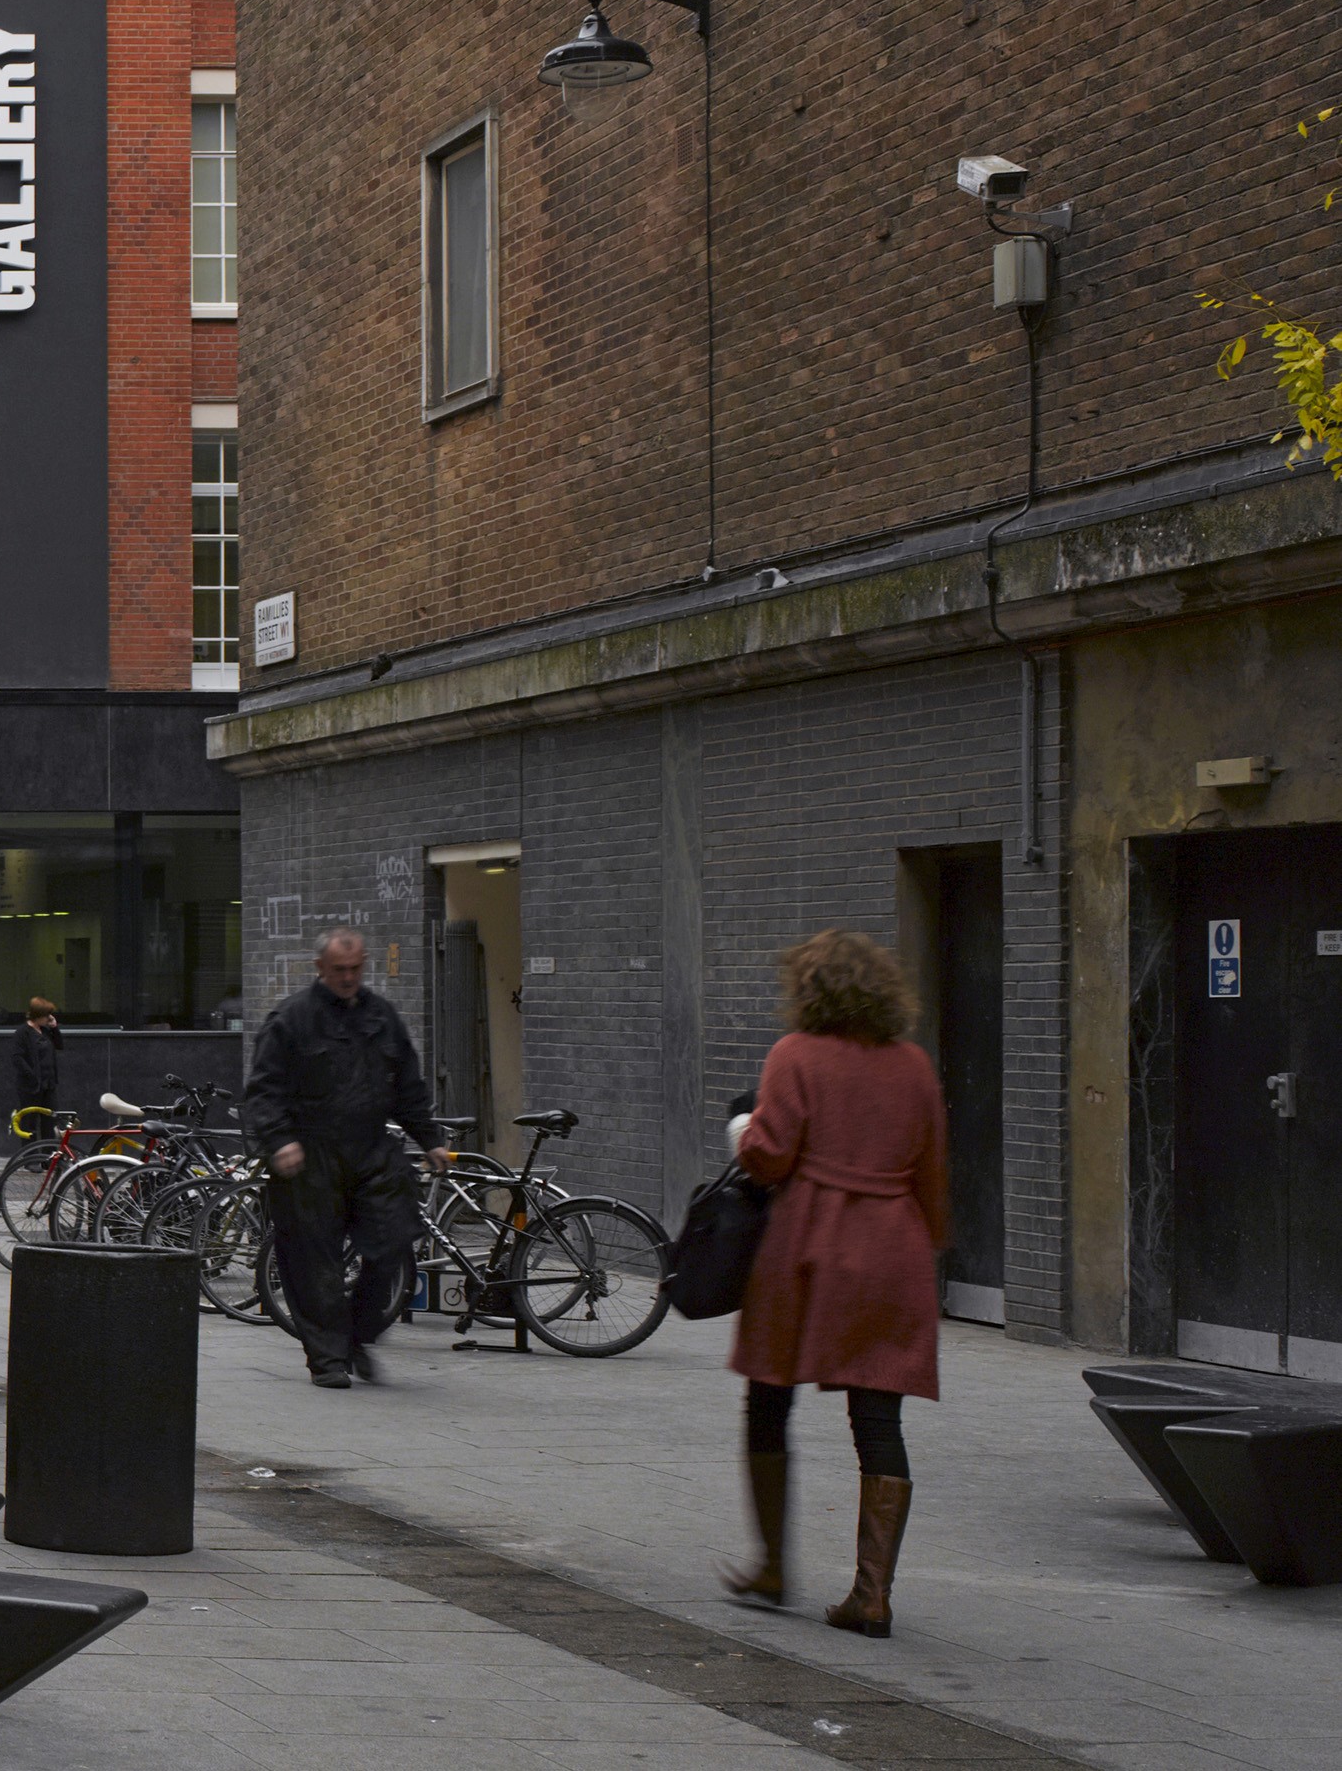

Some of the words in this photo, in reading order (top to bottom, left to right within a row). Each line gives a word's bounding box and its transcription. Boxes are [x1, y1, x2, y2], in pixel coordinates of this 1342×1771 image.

[258, 600, 288, 624] RAMILLIES
[258, 624, 279, 644] STREET
[1324, 934, 1338, 942] FIRE
[1325, 944, 1341, 952] KEEP
